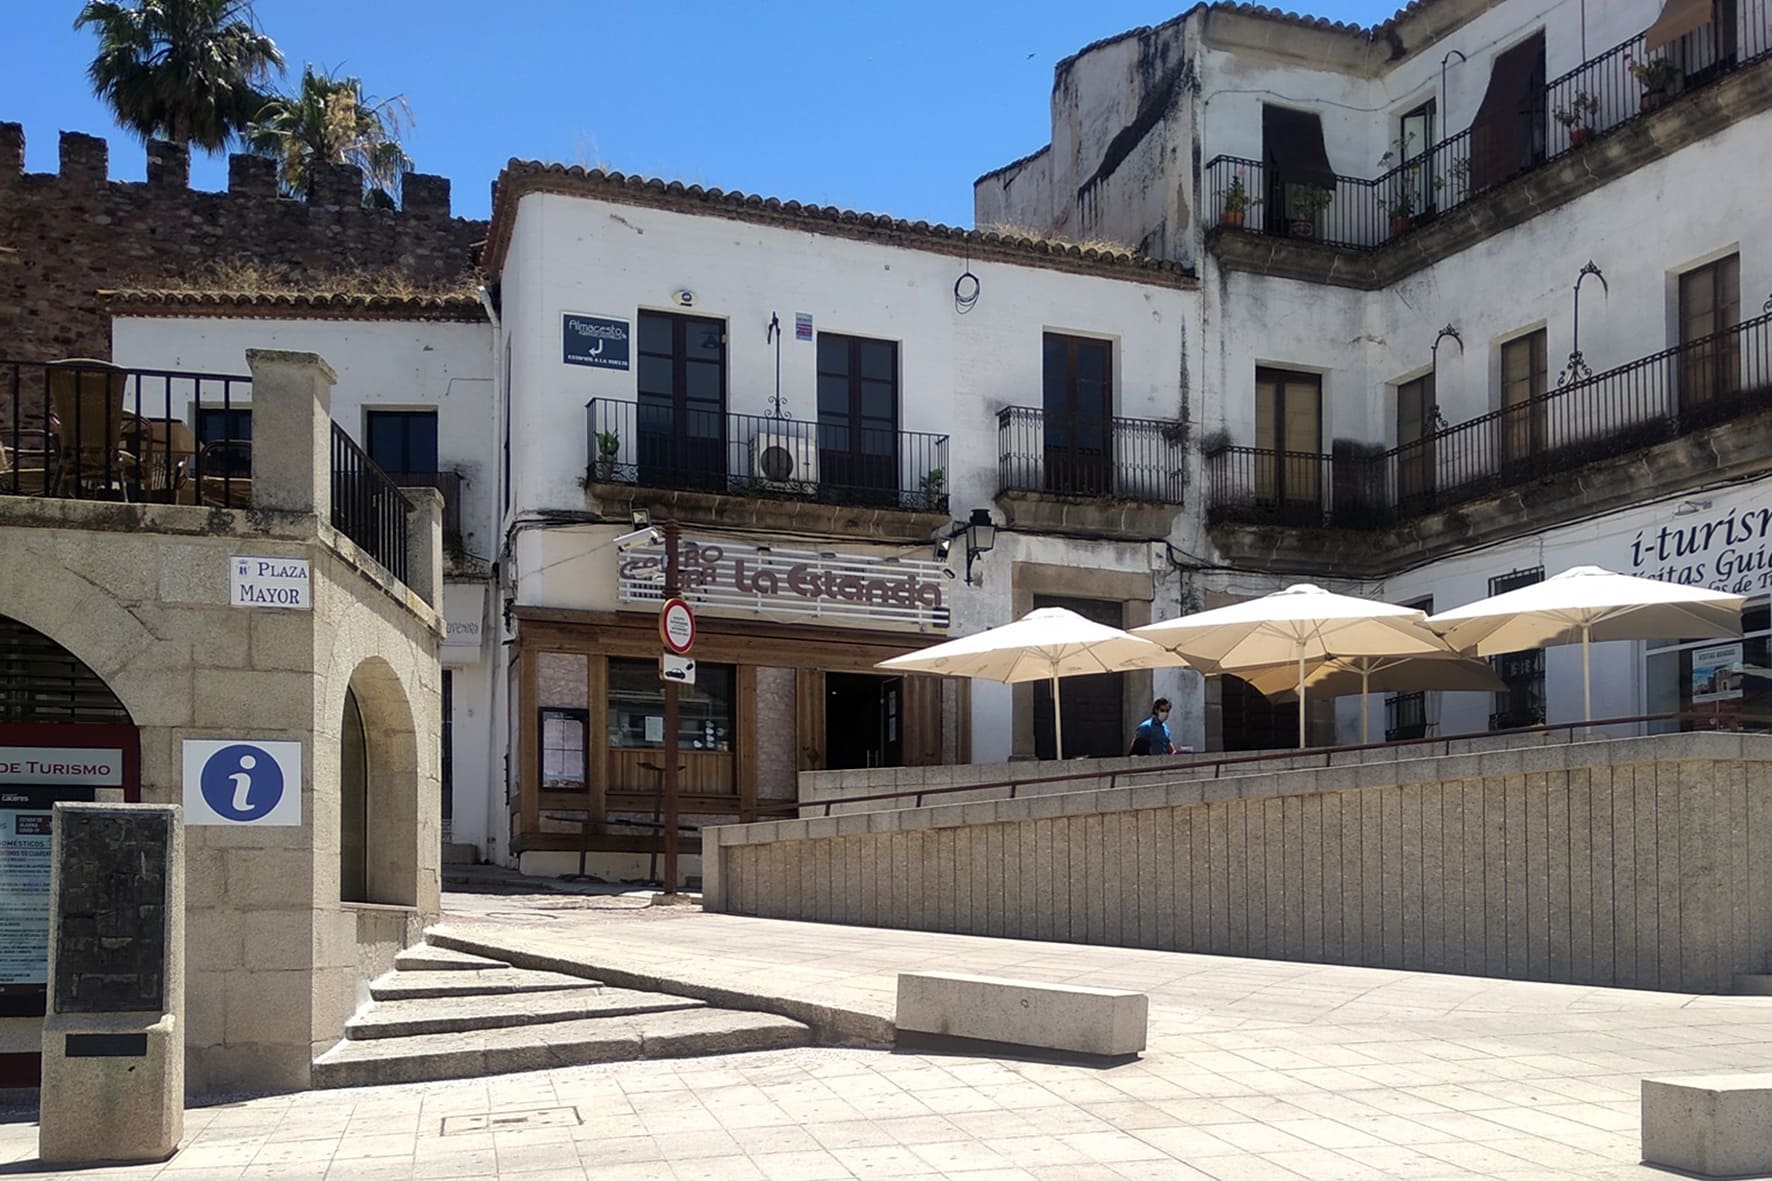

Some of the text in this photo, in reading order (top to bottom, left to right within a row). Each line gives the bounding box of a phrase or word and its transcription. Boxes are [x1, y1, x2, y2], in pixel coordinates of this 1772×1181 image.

[257, 561, 307, 578] PLAZA
[1716, 544, 1772, 582] Gui
[240, 583, 299, 604] MAYOR
[734, 559, 942, 608] La Estancia
[0, 761, 111, 776] DE TURISMO
